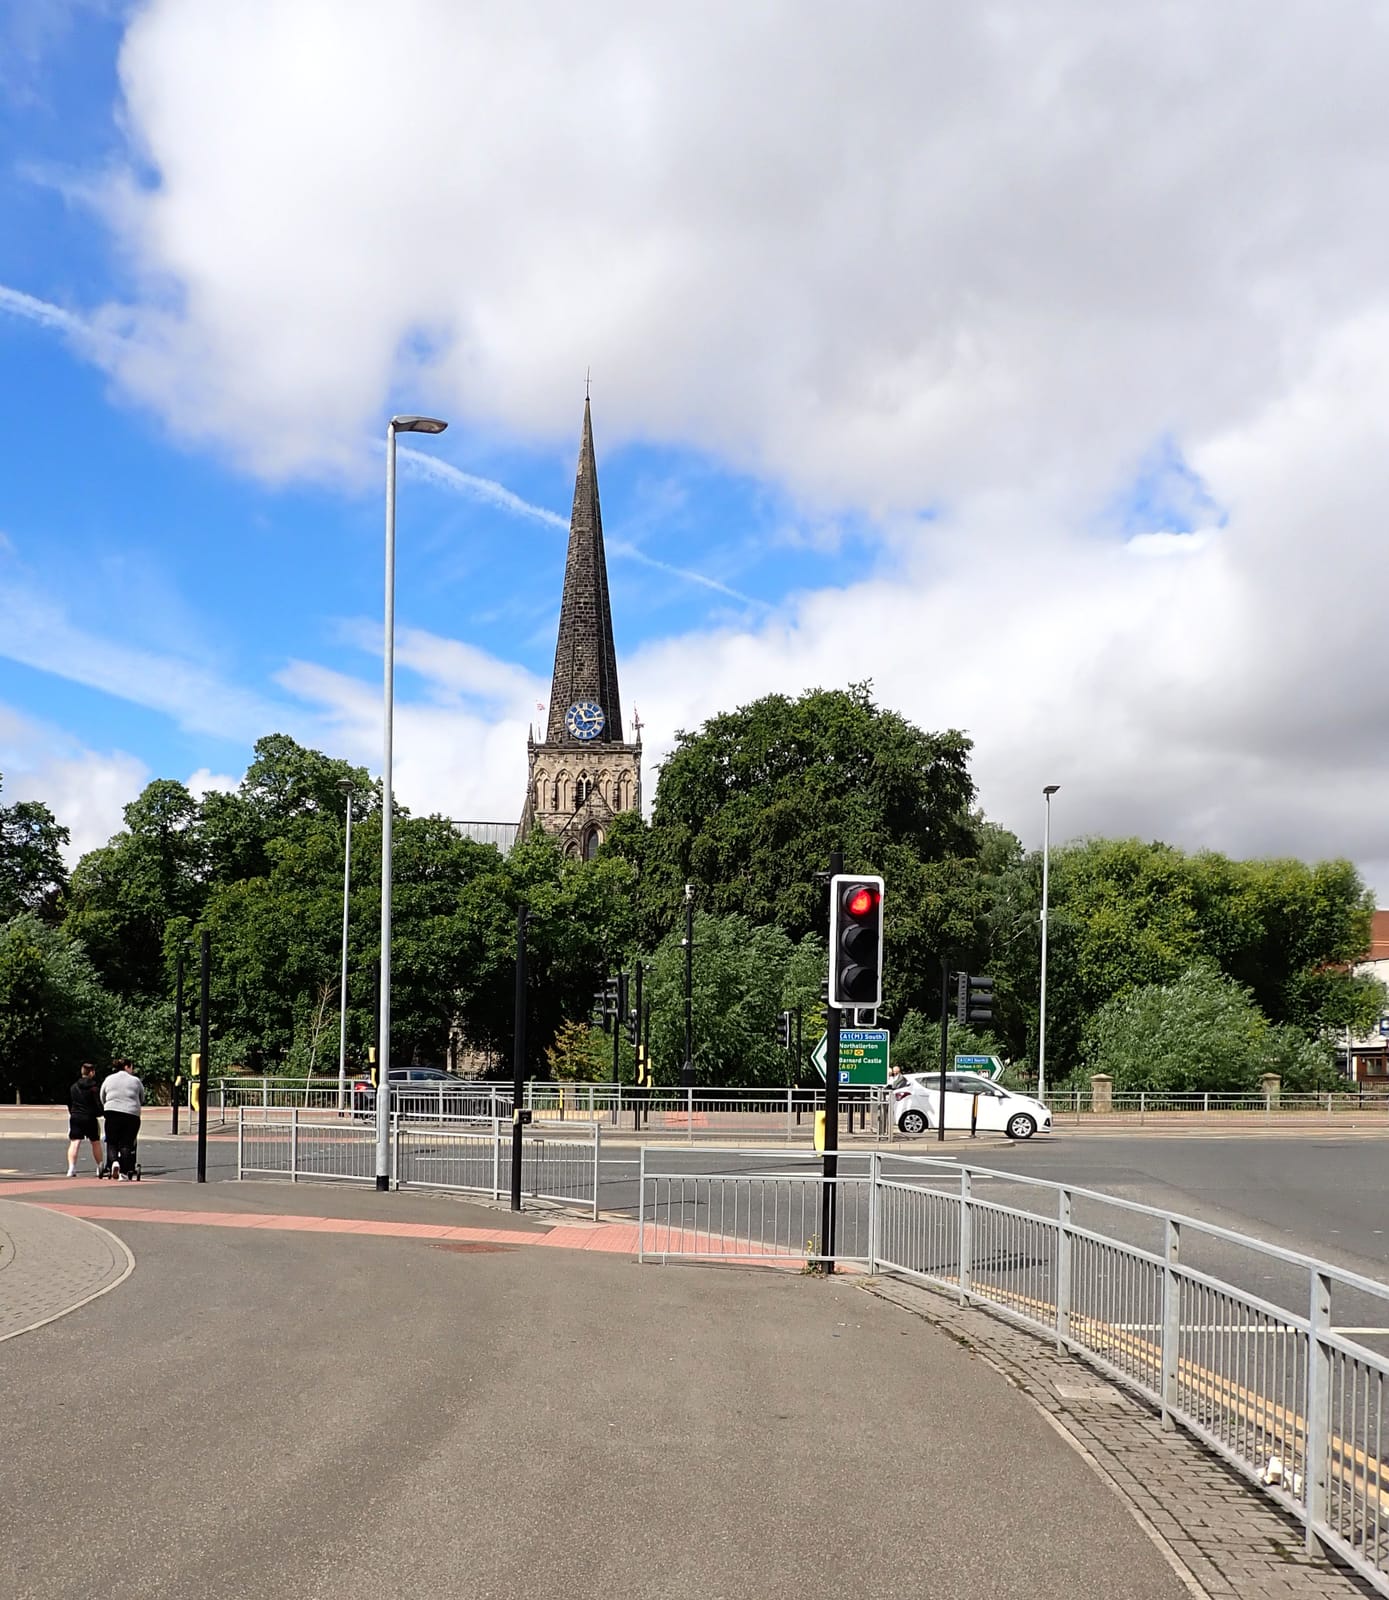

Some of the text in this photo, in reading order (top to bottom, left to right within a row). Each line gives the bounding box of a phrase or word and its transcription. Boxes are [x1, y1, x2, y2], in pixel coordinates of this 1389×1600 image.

[840, 1032, 885, 1040] (A1(M) South)
[840, 1072, 848, 1082] P
